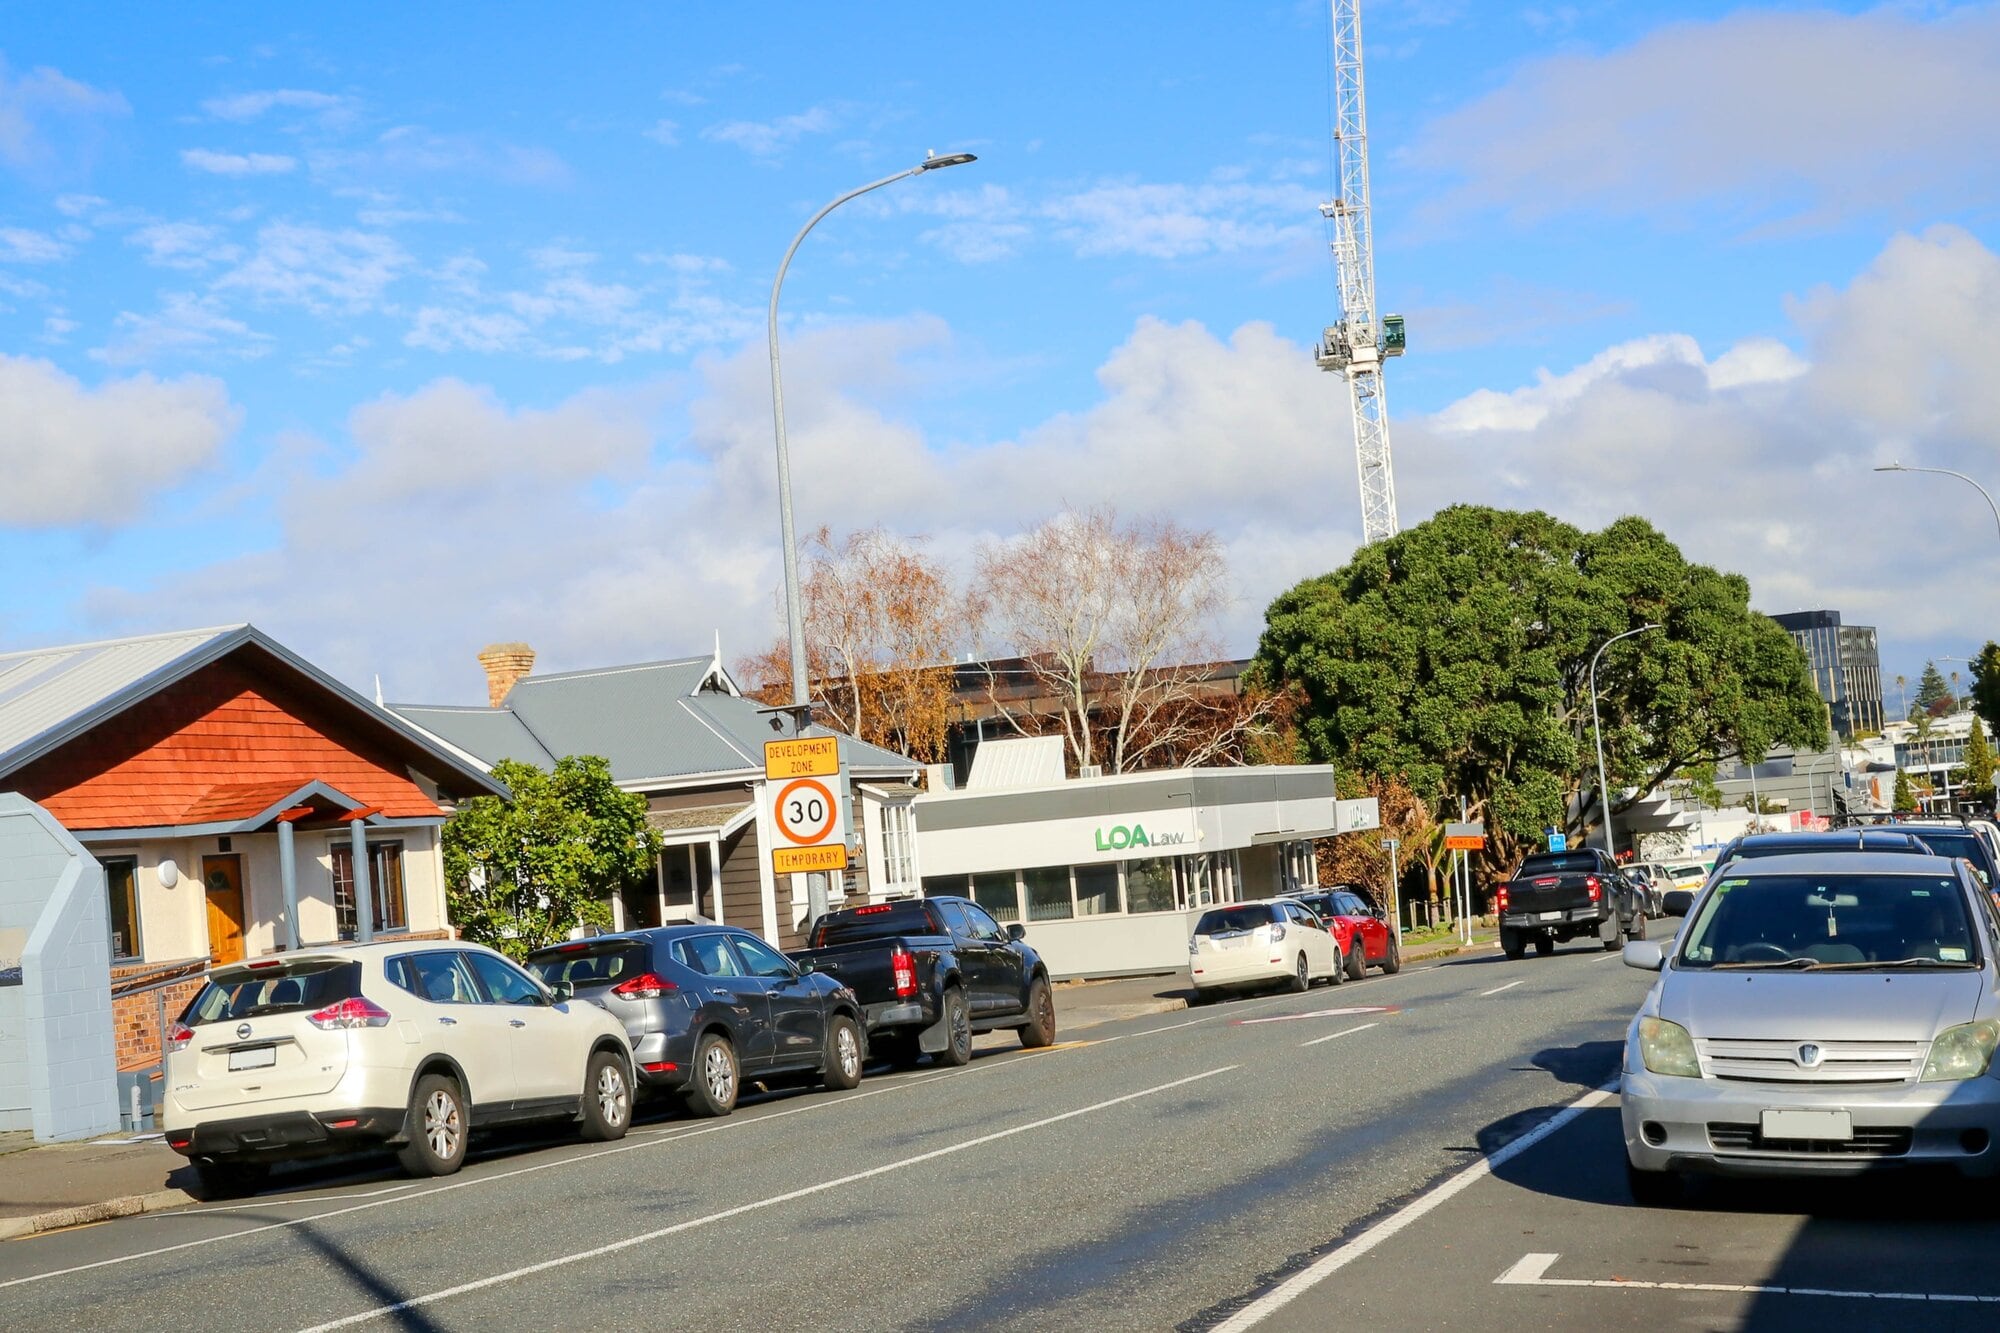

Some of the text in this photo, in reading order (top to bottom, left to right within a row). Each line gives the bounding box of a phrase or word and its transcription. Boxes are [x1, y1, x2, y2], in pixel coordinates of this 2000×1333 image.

[769, 742, 832, 758] DEVELOPMENT
[791, 760, 813, 773] ZONE
[789, 799, 823, 824] 30
[1095, 824, 1184, 851] LOA Law
[780, 851, 838, 866] TEMPORARY
